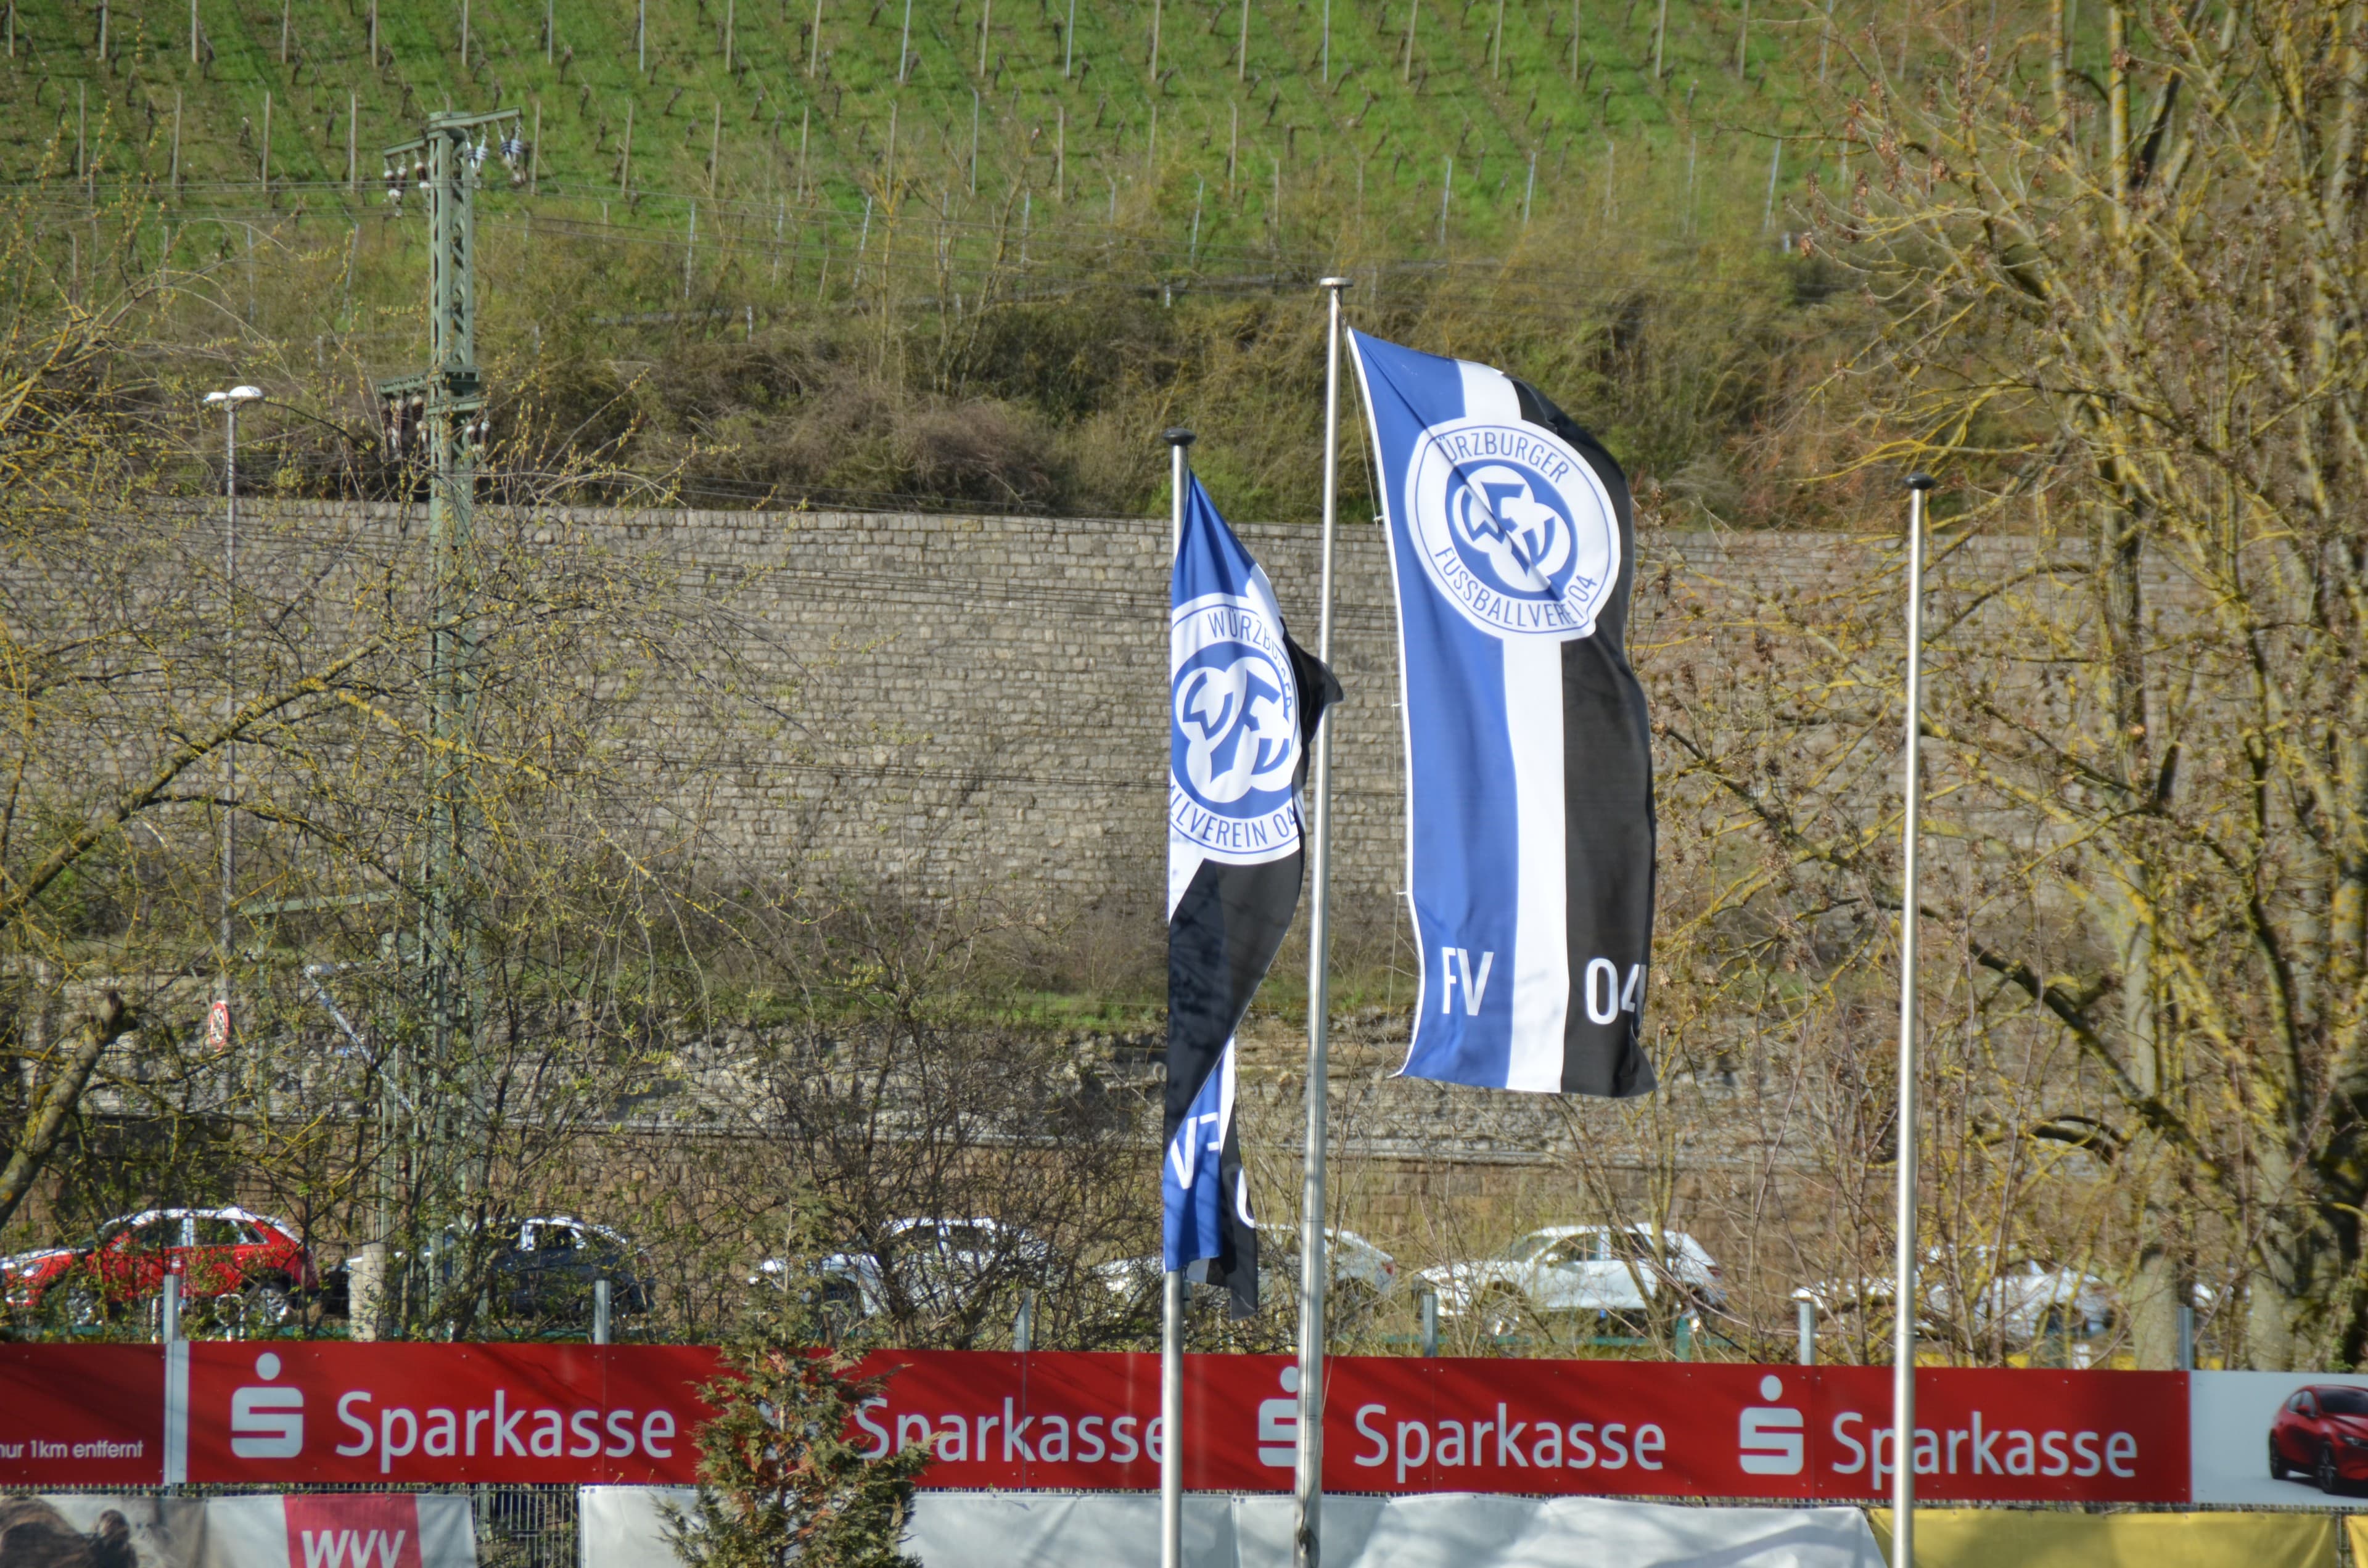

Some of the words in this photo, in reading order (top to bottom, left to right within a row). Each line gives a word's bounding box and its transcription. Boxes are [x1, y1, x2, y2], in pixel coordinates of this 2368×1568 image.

[1439, 432, 1569, 484] ÜRZBURGER
[1442, 946, 1494, 1016] FV
[1585, 958, 1647, 1025] 04
[72, 1440, 144, 1458] entfernt
[335, 1390, 675, 1474] Sparkasse
[1354, 1402, 1666, 1484] Sparkasse
[1832, 1411, 2138, 1490] Sparkasse
[302, 1529, 406, 1568] WVV
